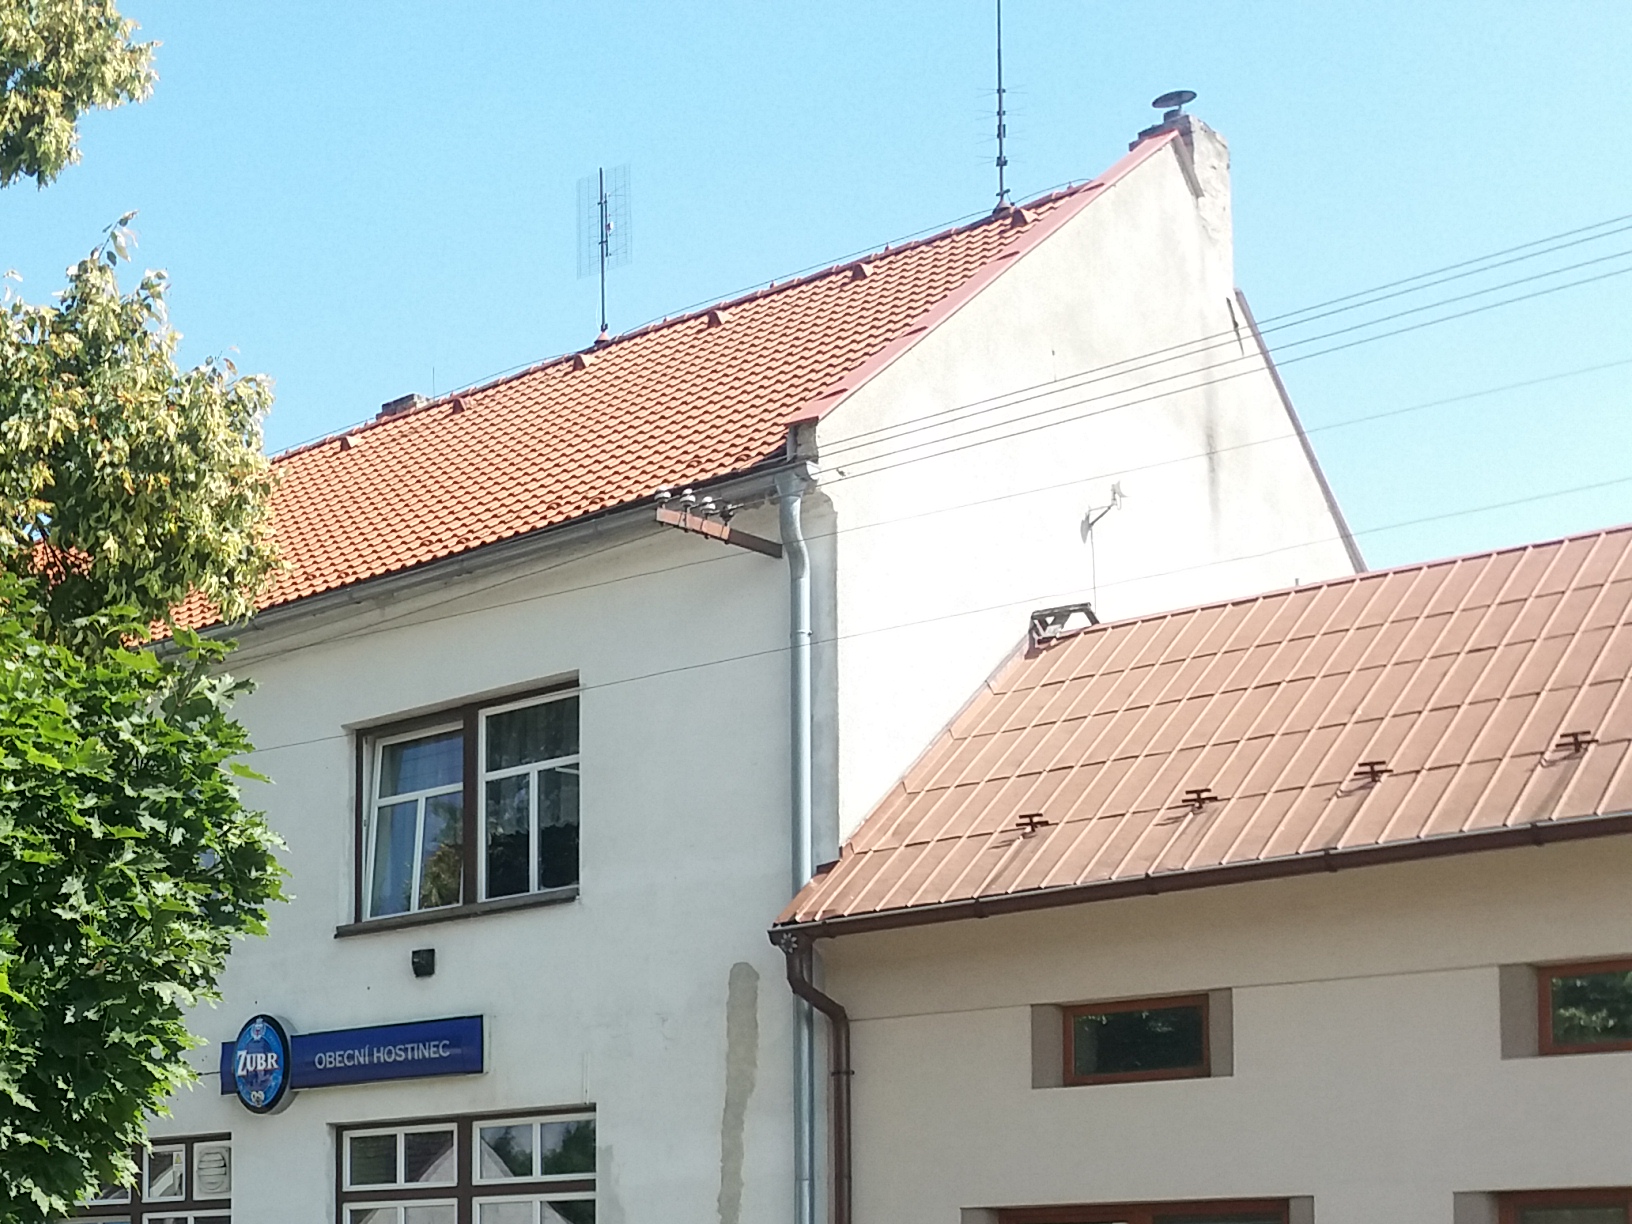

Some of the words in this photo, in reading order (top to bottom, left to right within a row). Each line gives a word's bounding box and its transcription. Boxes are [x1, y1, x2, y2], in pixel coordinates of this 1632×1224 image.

[236, 1049, 279, 1077] ZUBR
[314, 1044, 369, 1069] OBECNÍ
[373, 1040, 451, 1064] HOSTINEC
